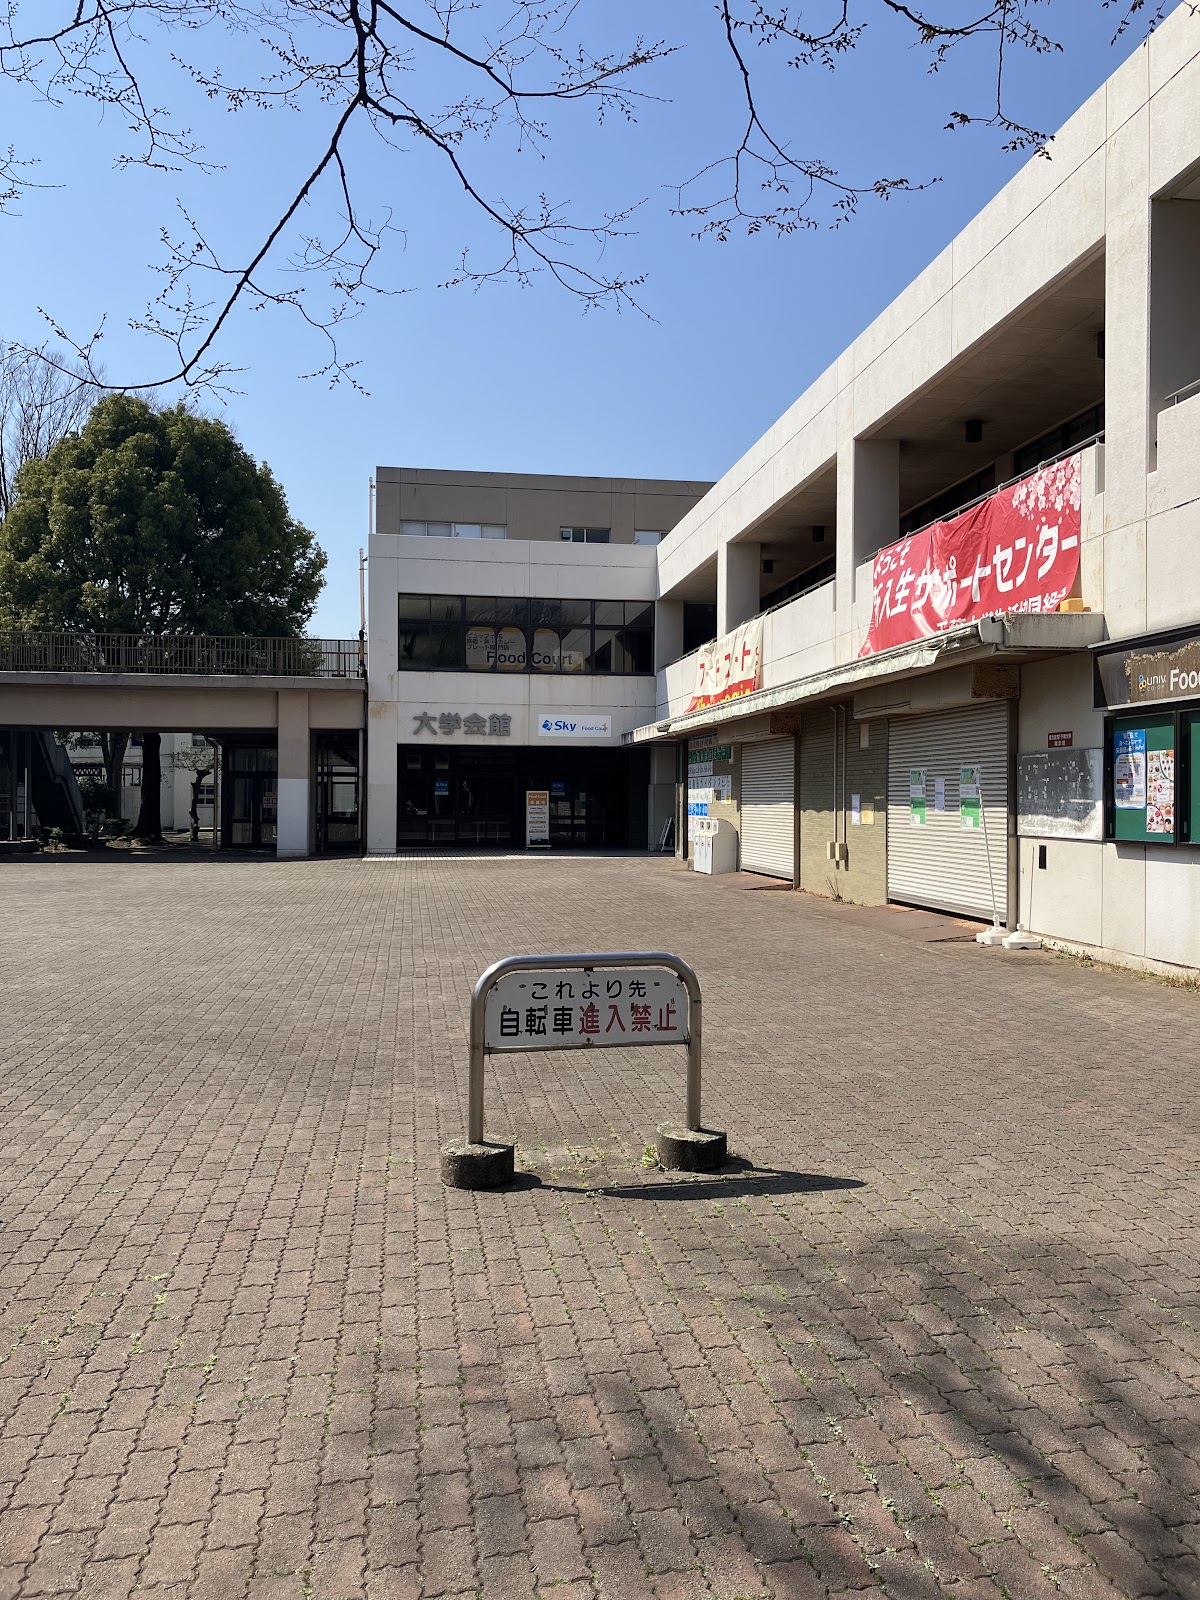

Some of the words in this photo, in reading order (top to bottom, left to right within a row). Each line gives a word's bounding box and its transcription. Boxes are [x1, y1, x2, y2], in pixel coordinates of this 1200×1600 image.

[874, 539, 912, 580] ようこそ
[486, 651, 526, 664] Food
[531, 652, 573, 665] Court
[1146, 674, 1167, 686] univ.
[413, 711, 512, 737] 大学会館
[554, 720, 577, 732] Sky
[531, 979, 647, 1000] これより先
[500, 1003, 678, 1037] 自転車進入禁止
